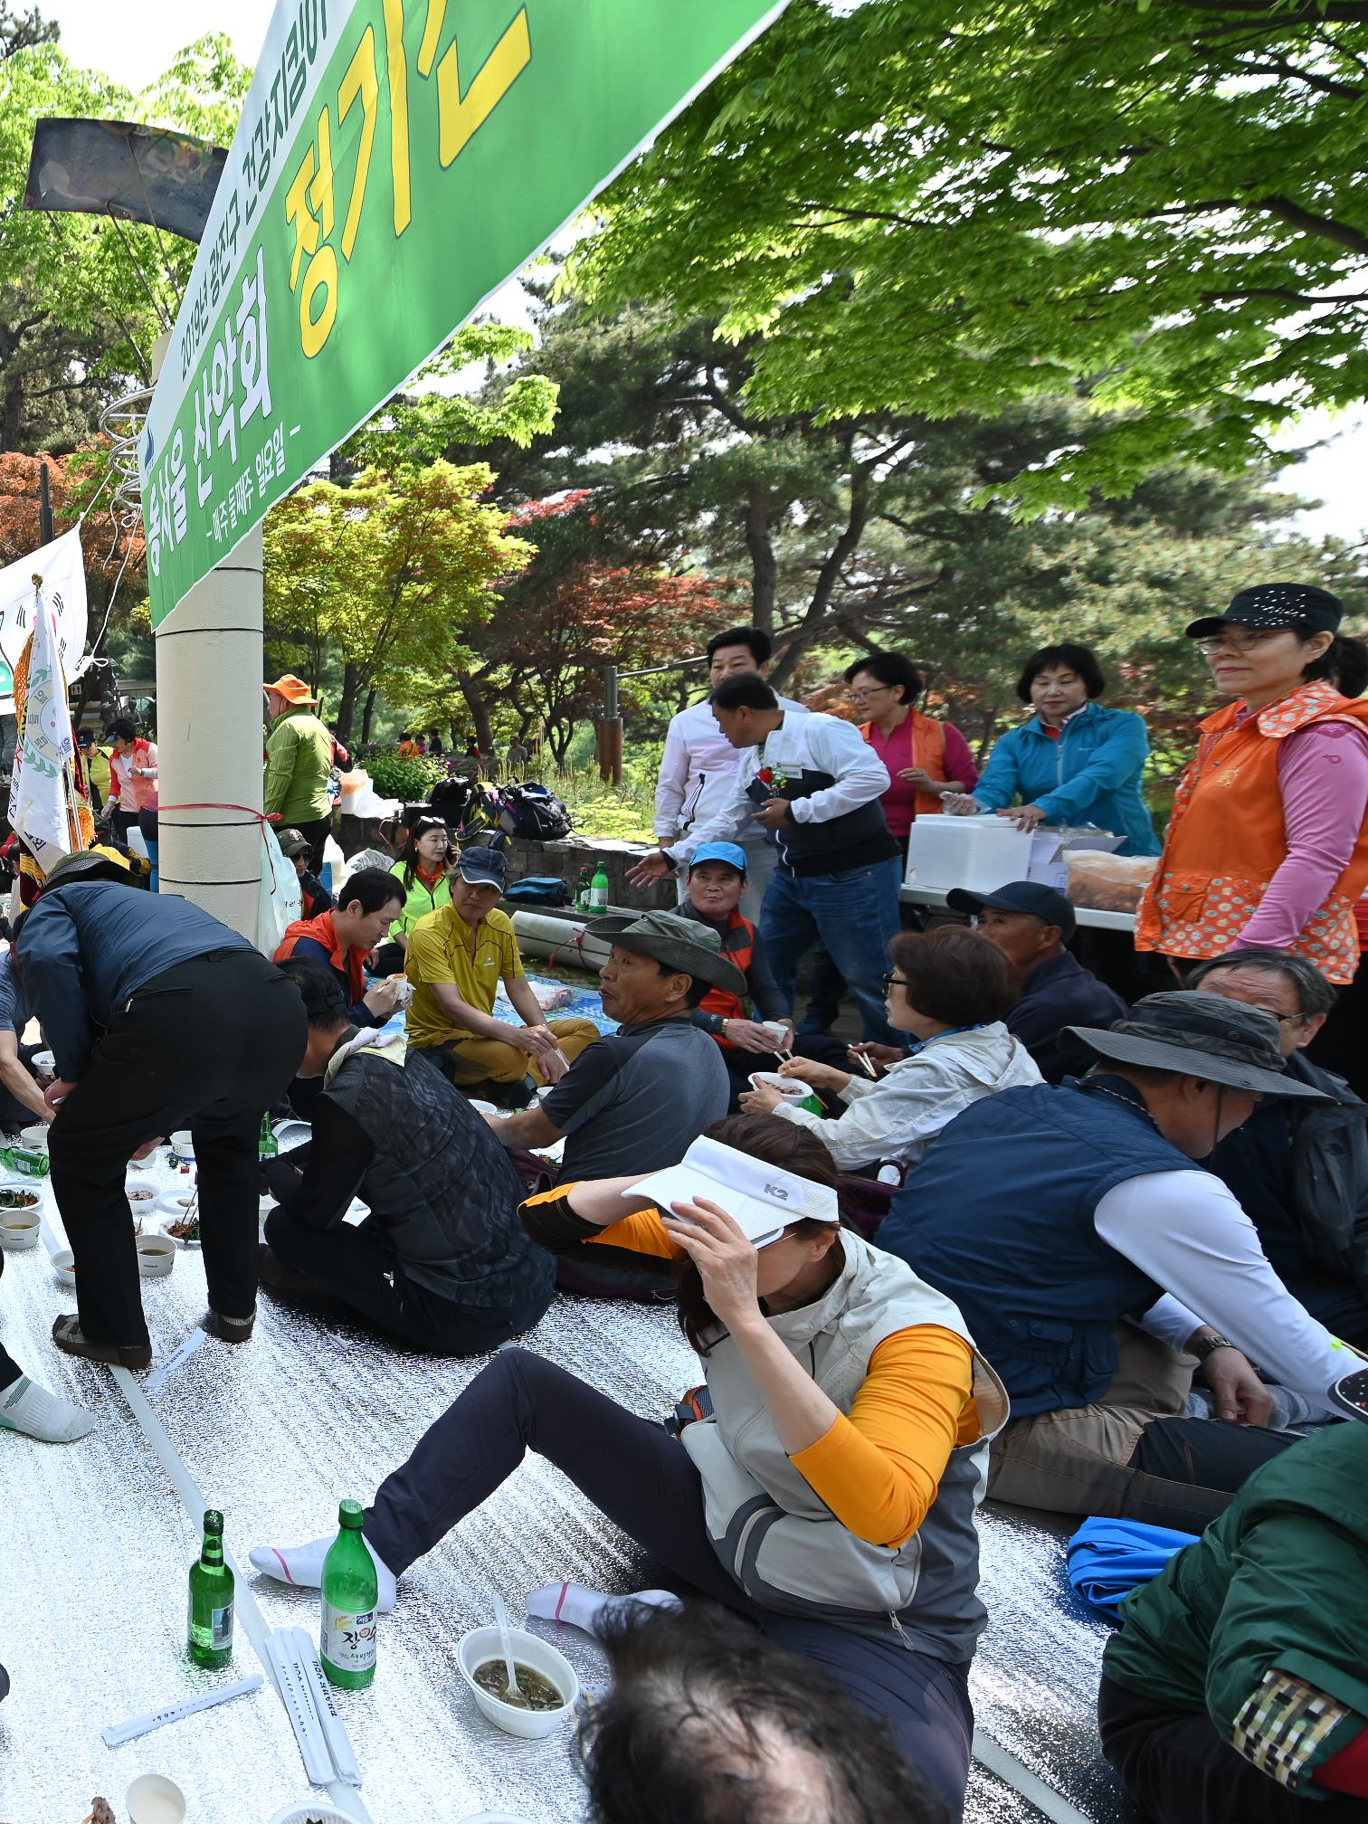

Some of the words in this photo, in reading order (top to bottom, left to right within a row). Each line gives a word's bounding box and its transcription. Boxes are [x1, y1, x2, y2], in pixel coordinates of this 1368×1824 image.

[182, 272, 209, 382] 2019년
[210, 189, 240, 308] 광진구
[148, 427, 188, 577] 동서울
[194, 244, 272, 509] 산악회
[255, 422, 285, 497] 일요일
[764, 1183, 789, 1201] K2
